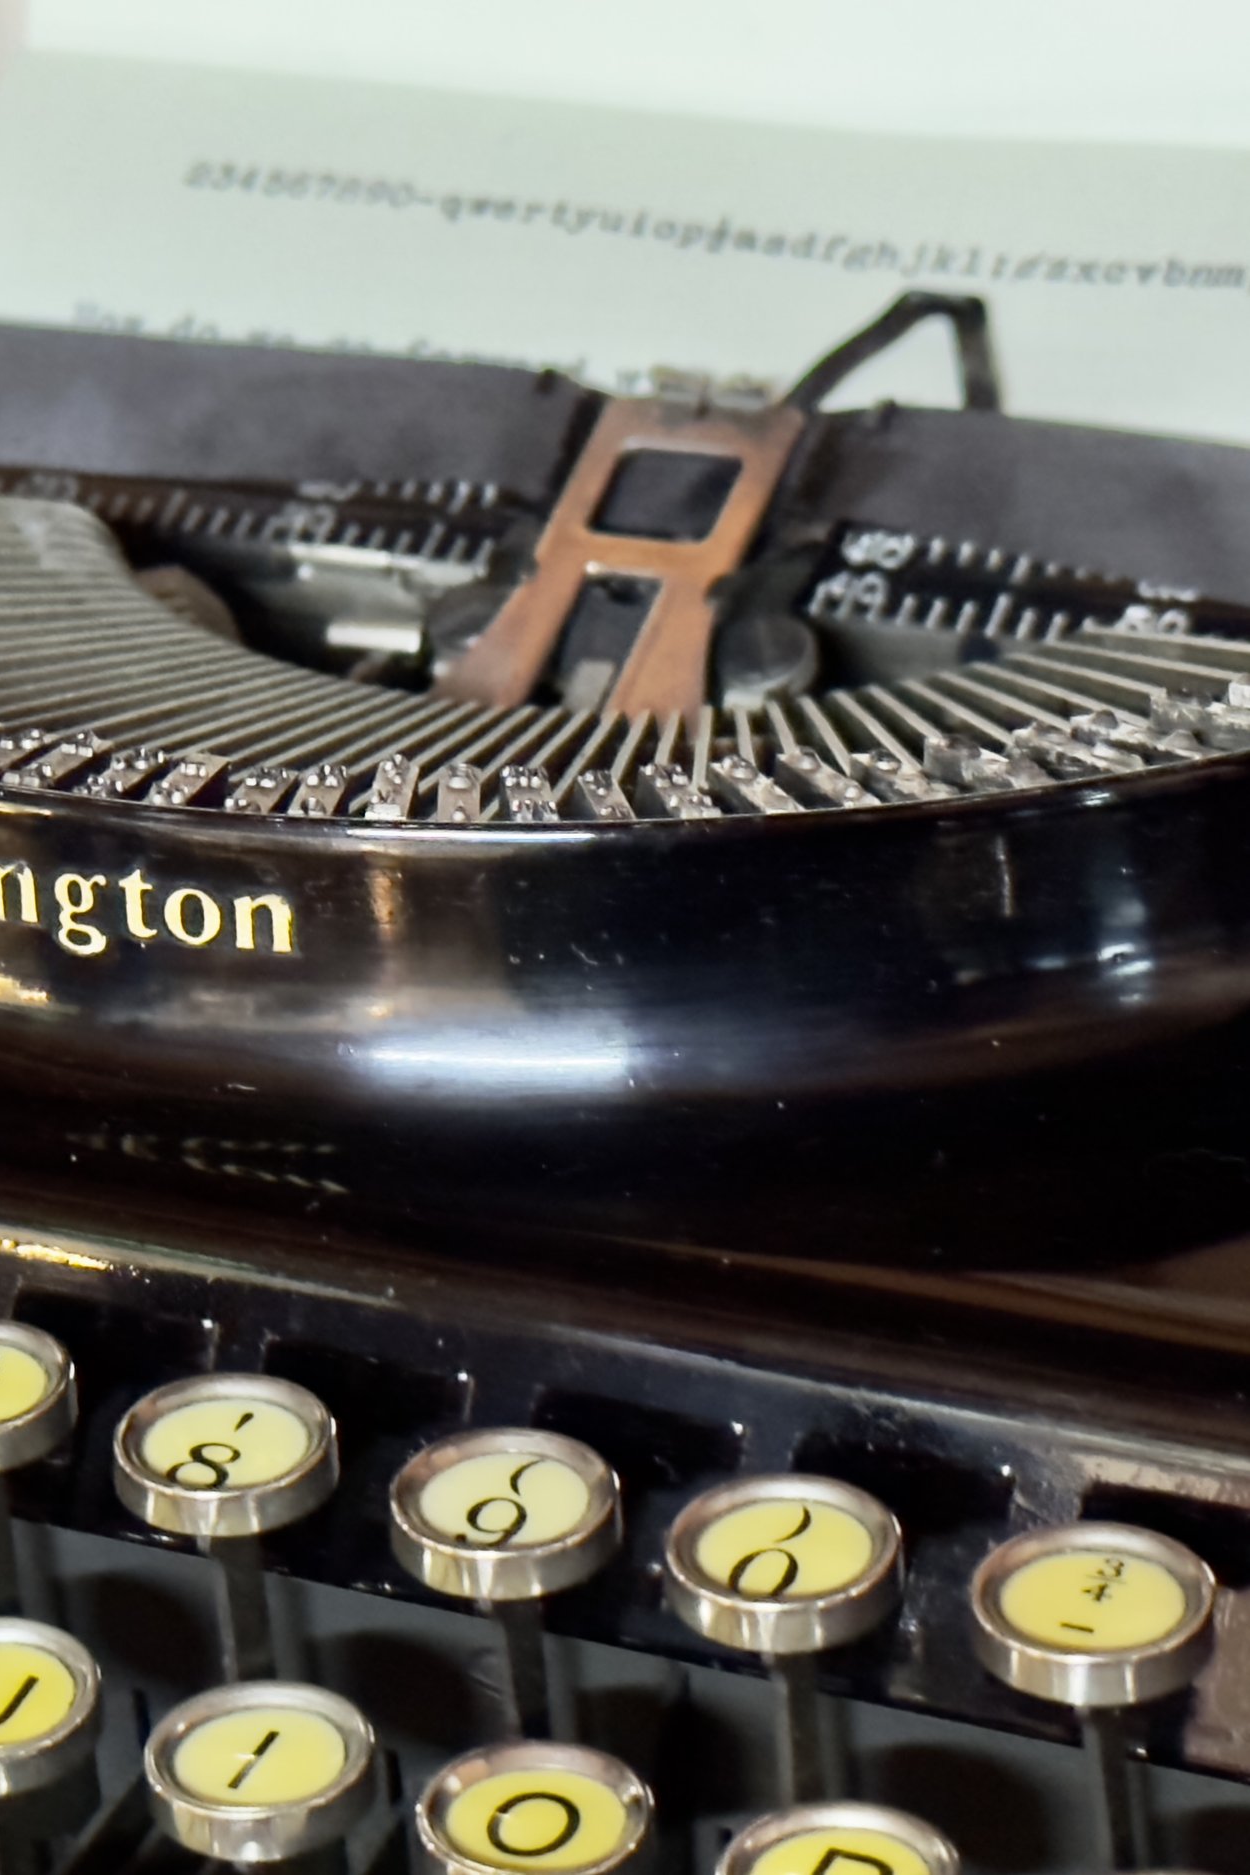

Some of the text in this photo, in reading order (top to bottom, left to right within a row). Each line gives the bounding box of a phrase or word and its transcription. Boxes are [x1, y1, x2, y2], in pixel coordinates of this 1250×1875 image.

[165, 1441, 242, 1490] 8
[454, 1496, 529, 1549] 9
[227, 1729, 282, 1791] I
[486, 1791, 582, 1857] O
